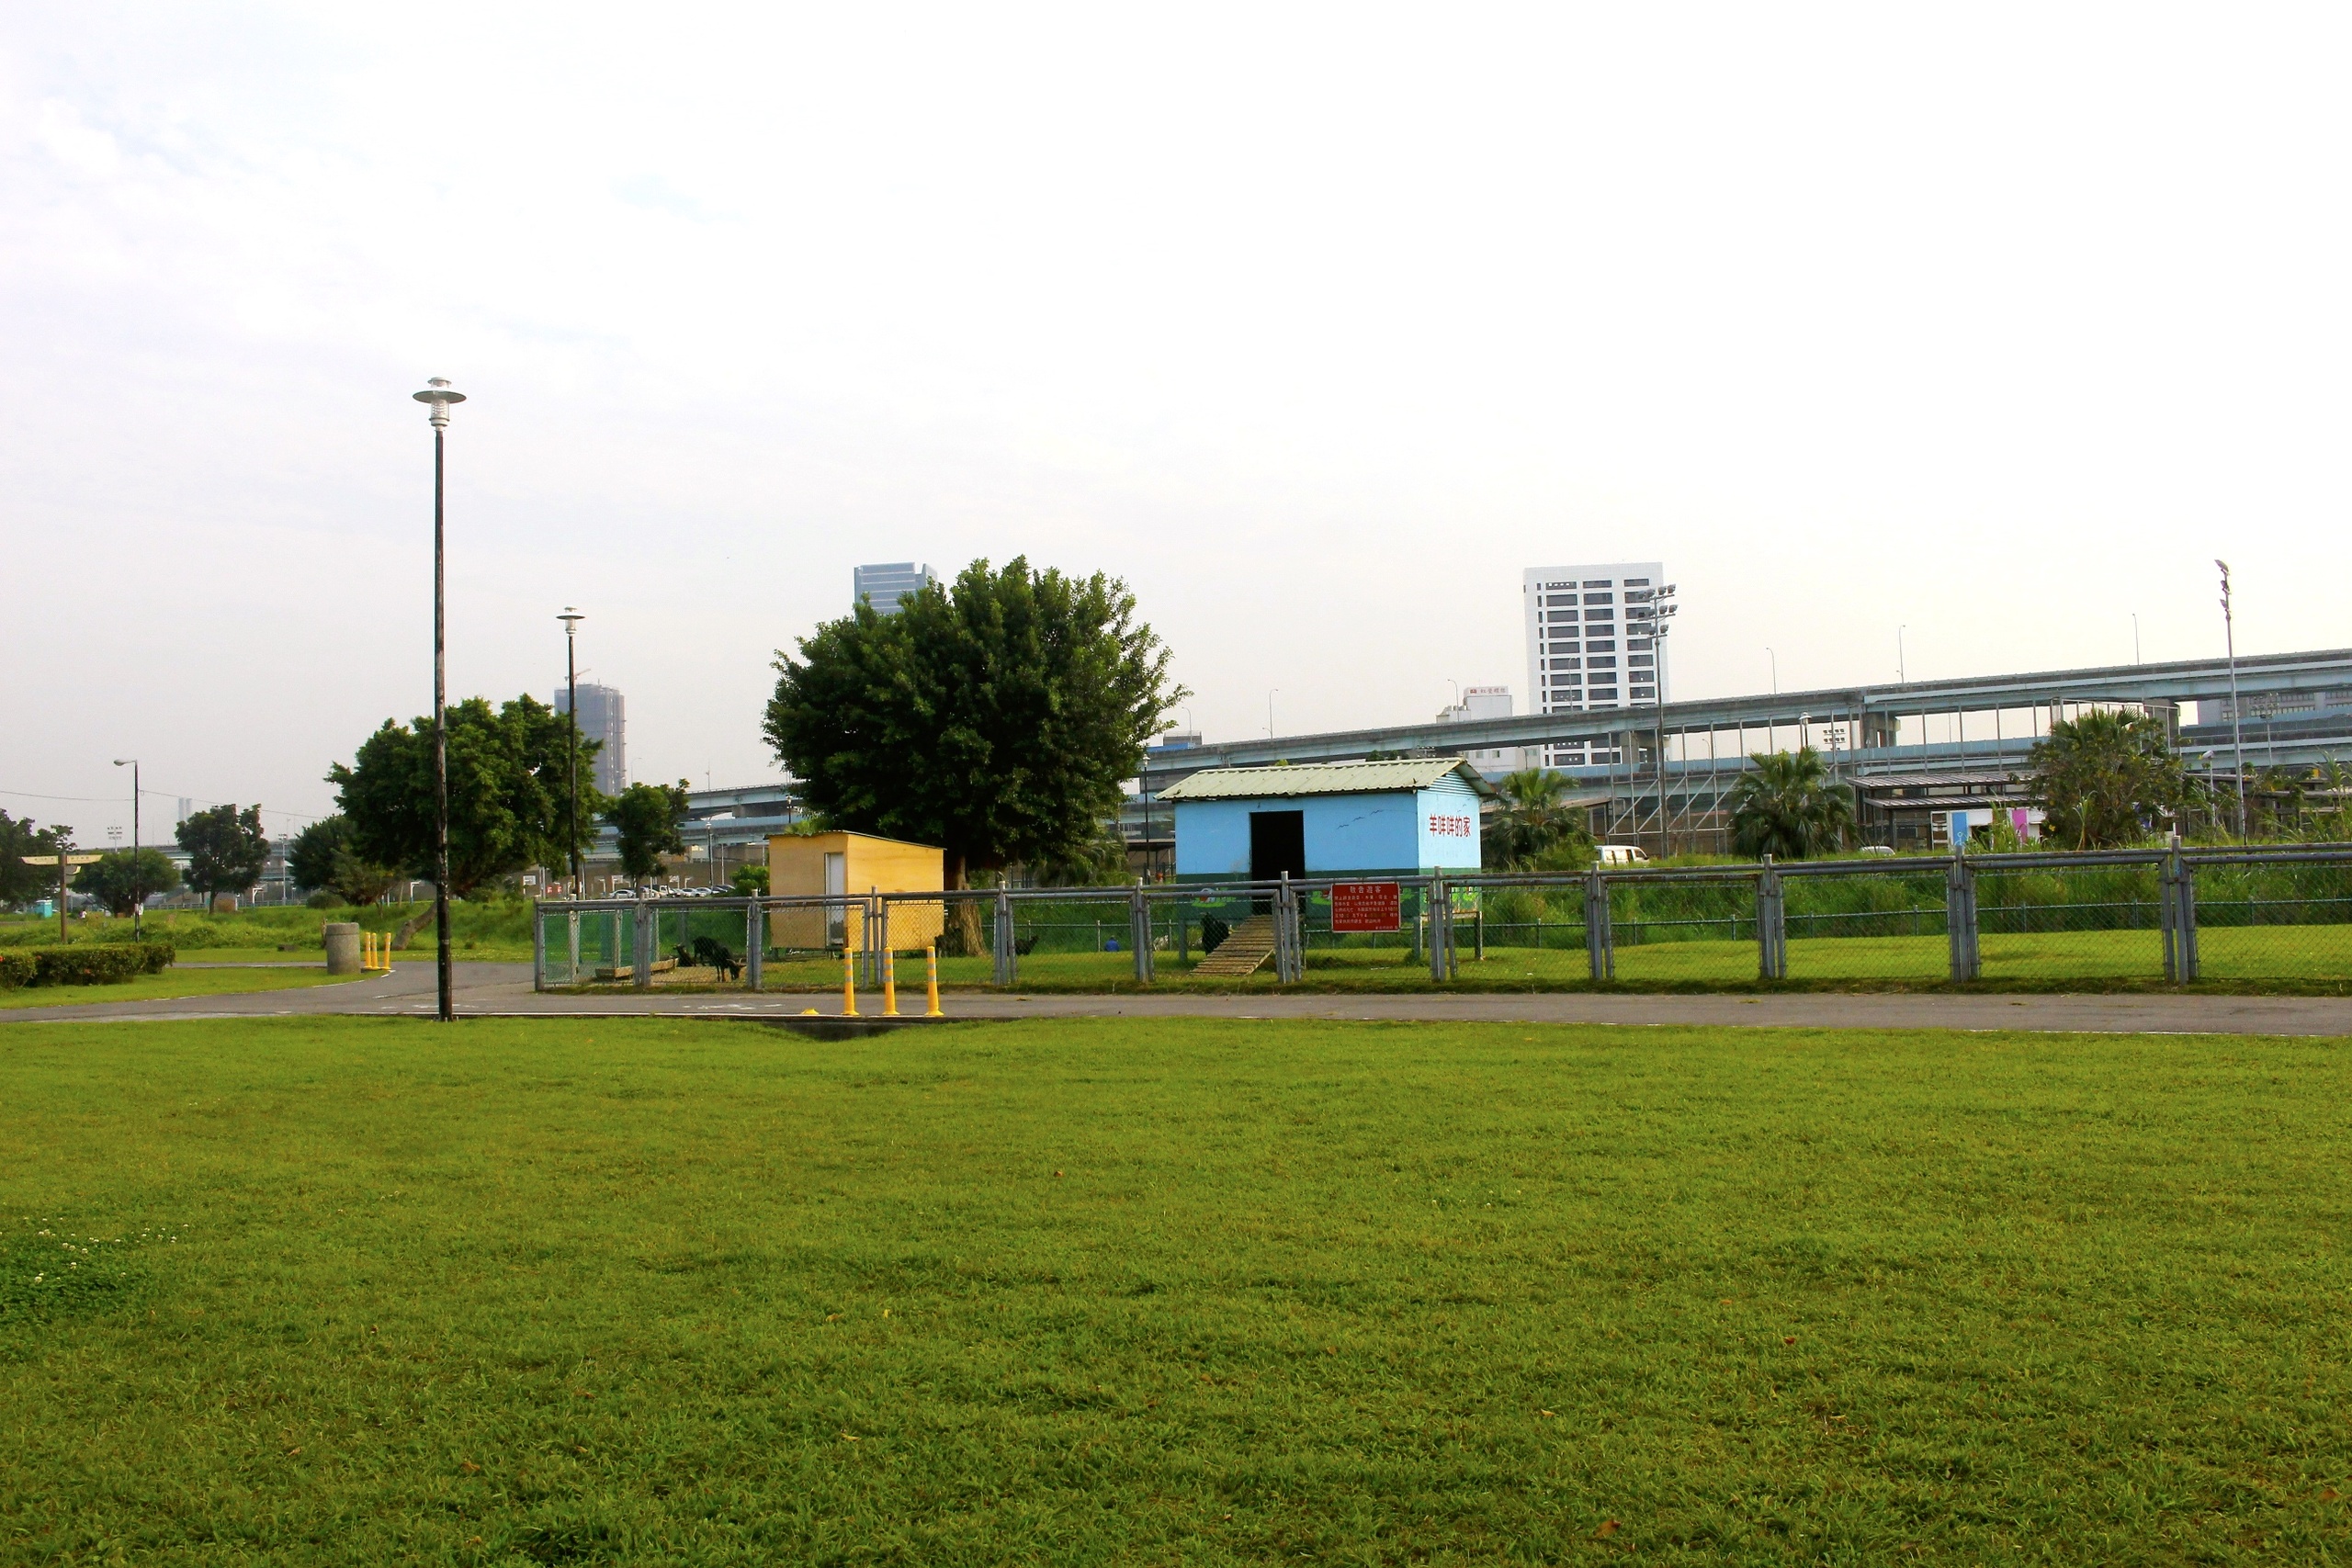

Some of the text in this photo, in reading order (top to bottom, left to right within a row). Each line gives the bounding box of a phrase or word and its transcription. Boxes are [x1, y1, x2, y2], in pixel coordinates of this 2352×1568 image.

[1430, 814, 1471, 837] 羊咩咩的家
